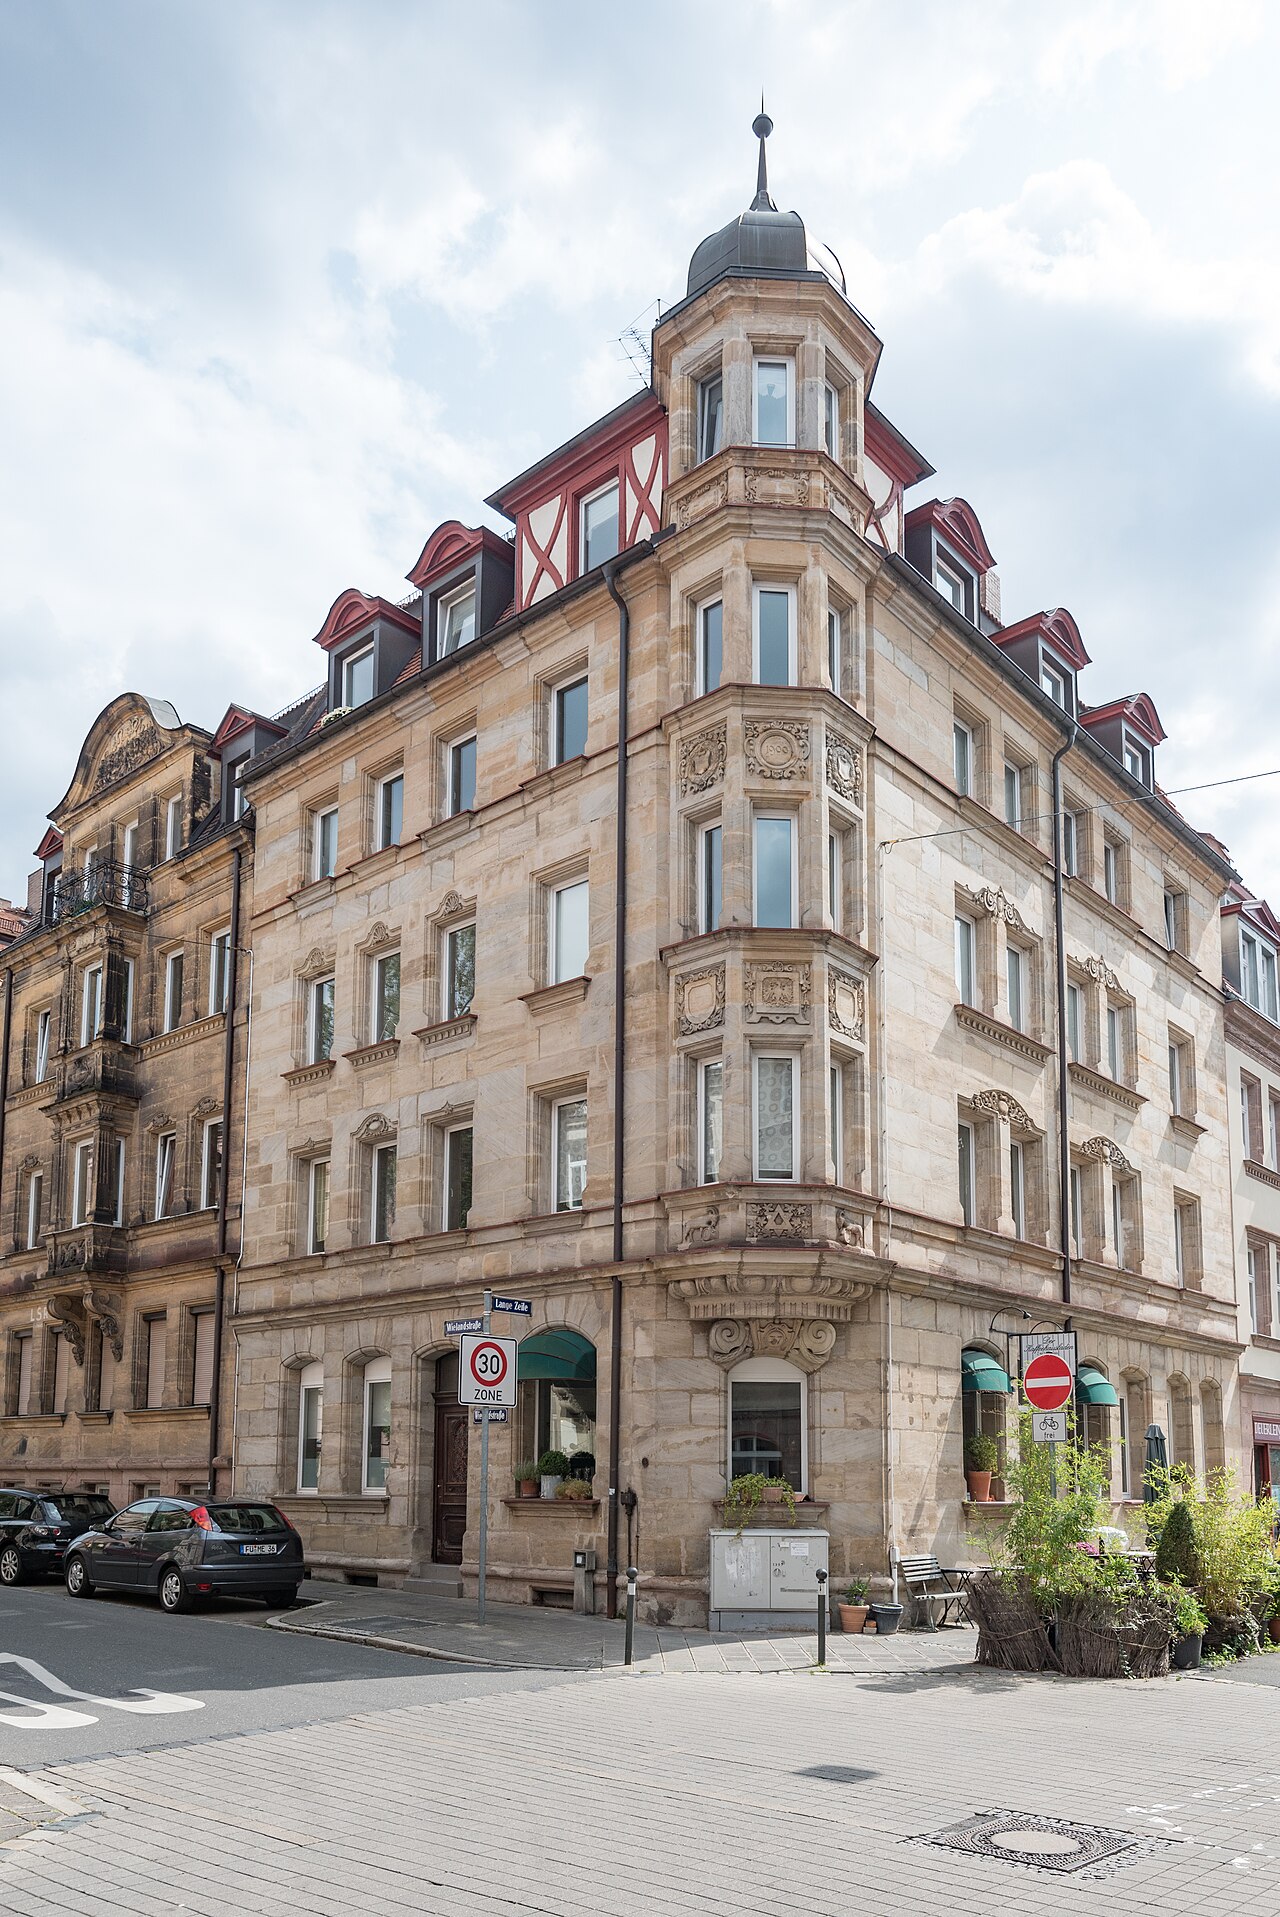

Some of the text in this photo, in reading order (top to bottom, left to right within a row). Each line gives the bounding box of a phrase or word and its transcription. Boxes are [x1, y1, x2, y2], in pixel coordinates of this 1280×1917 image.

[766, 745, 789, 757] 1900
[495, 1298, 529, 1312] Lange Zeile
[446, 1320, 481, 1331] Wielandstraße
[478, 1353, 500, 1375] 30
[474, 1388, 503, 1401] ZONE
[1044, 1431, 1055, 1439] frei
